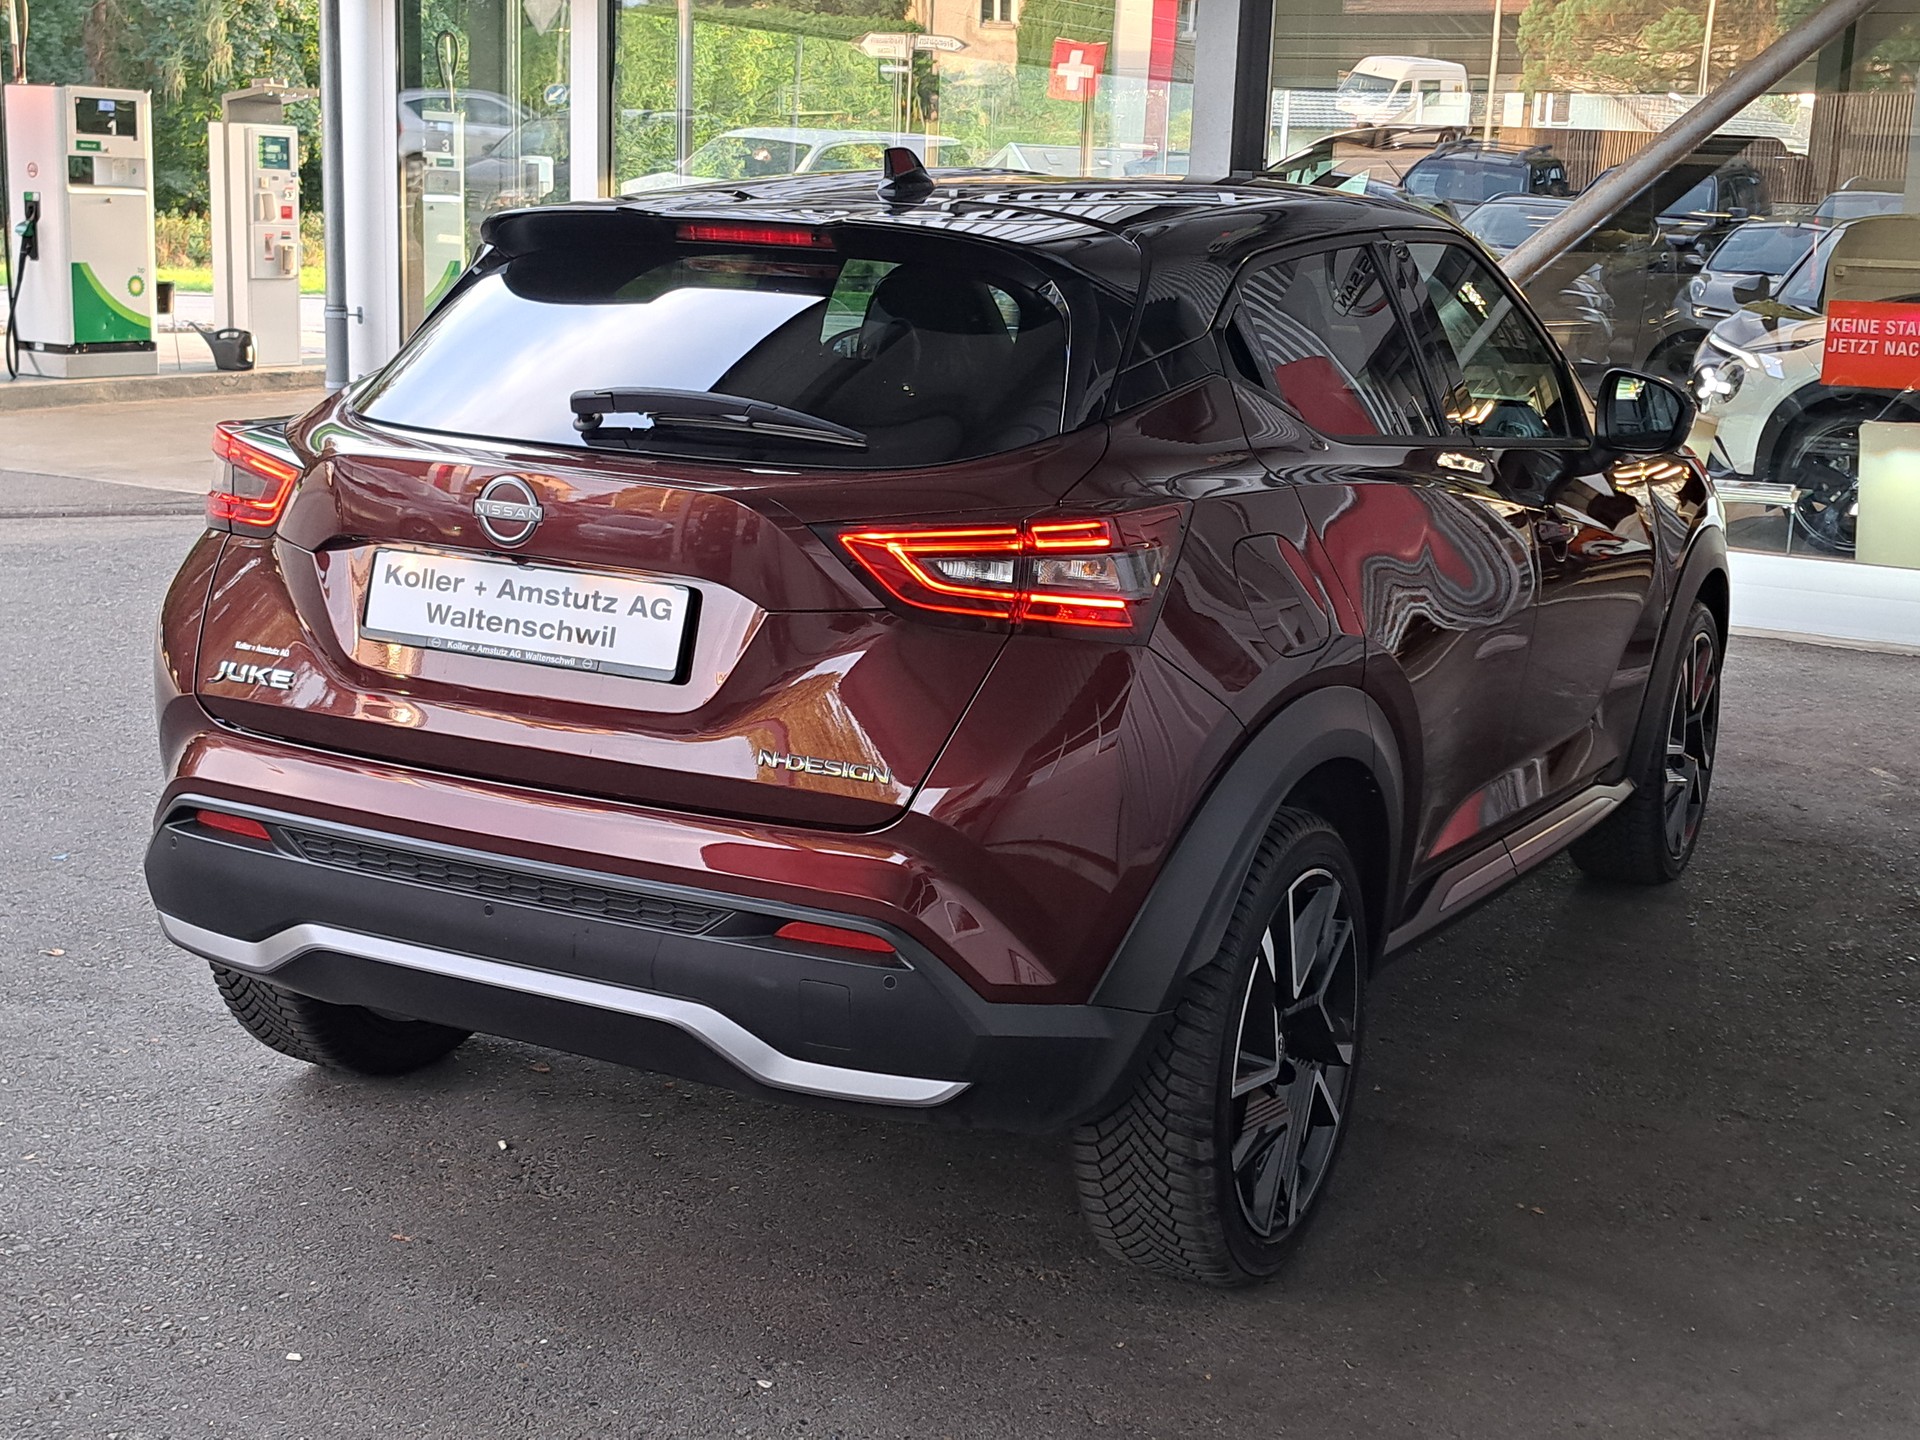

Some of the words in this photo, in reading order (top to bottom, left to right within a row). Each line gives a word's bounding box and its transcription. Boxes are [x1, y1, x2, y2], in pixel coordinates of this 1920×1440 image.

[107, 120, 117, 136] 1
[441, 139, 450, 152] 3
[1830, 317, 1880, 334] KEINE
[1827, 338, 1879, 355] JETZT
[476, 502, 541, 519] NISSAN
[384, 563, 465, 593] Koller
[474, 581, 488, 596] +
[496, 578, 619, 614] Amstutz
[627, 595, 673, 621] AG
[426, 602, 617, 649] Waltenschwil
[447, 640, 469, 651] Koller
[477, 645, 508, 657] Amstutz
[509, 650, 521, 659] AG
[525, 652, 576, 666] Waltenschwil
[207, 660, 296, 690] JUKE
[757, 748, 892, 784] N-DESIGN
